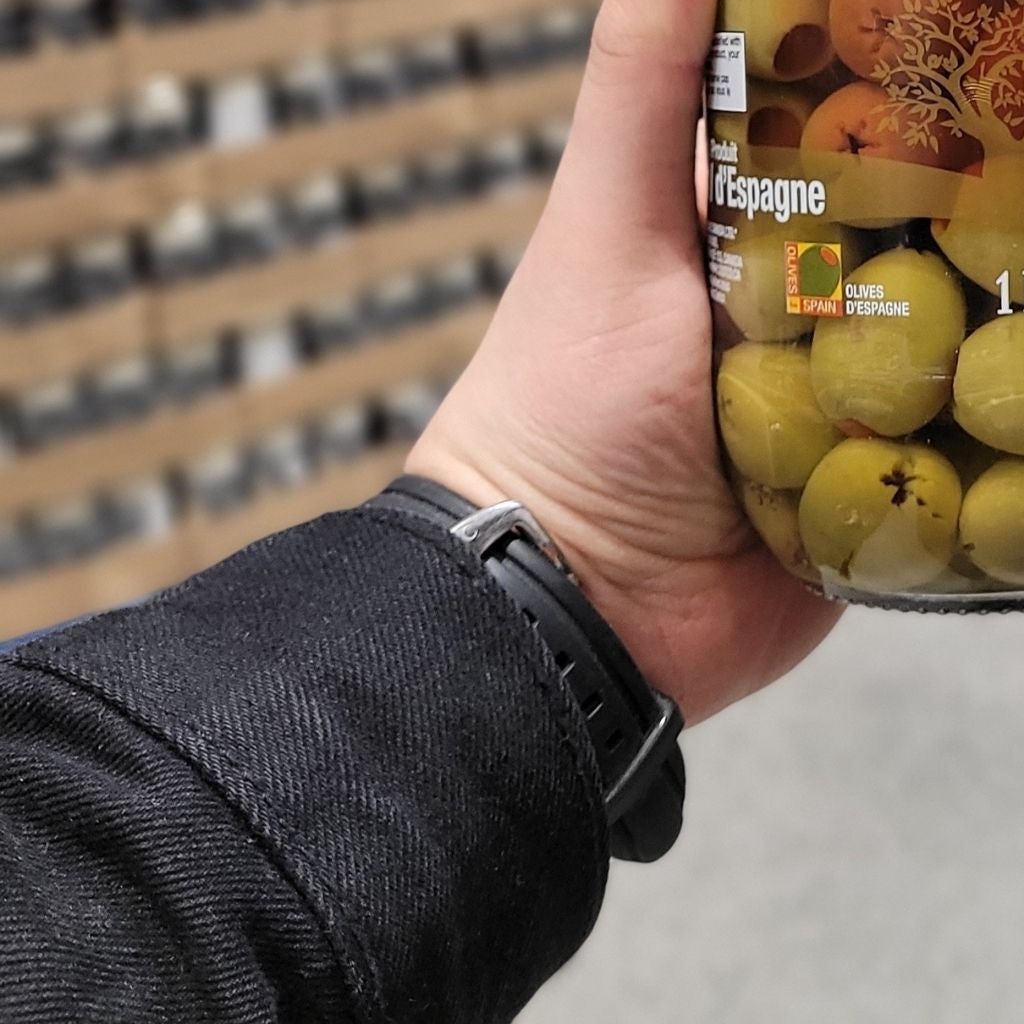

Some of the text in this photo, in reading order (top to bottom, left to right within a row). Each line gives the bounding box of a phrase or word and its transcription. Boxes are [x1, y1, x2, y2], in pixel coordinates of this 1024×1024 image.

[715, 165, 826, 223] d'Espagne
[787, 246, 799, 295] OLIVES
[845, 284, 884, 298] OLIVES
[803, 298, 837, 314] SPAIN
[846, 301, 910, 317] D'ESPAGNE
